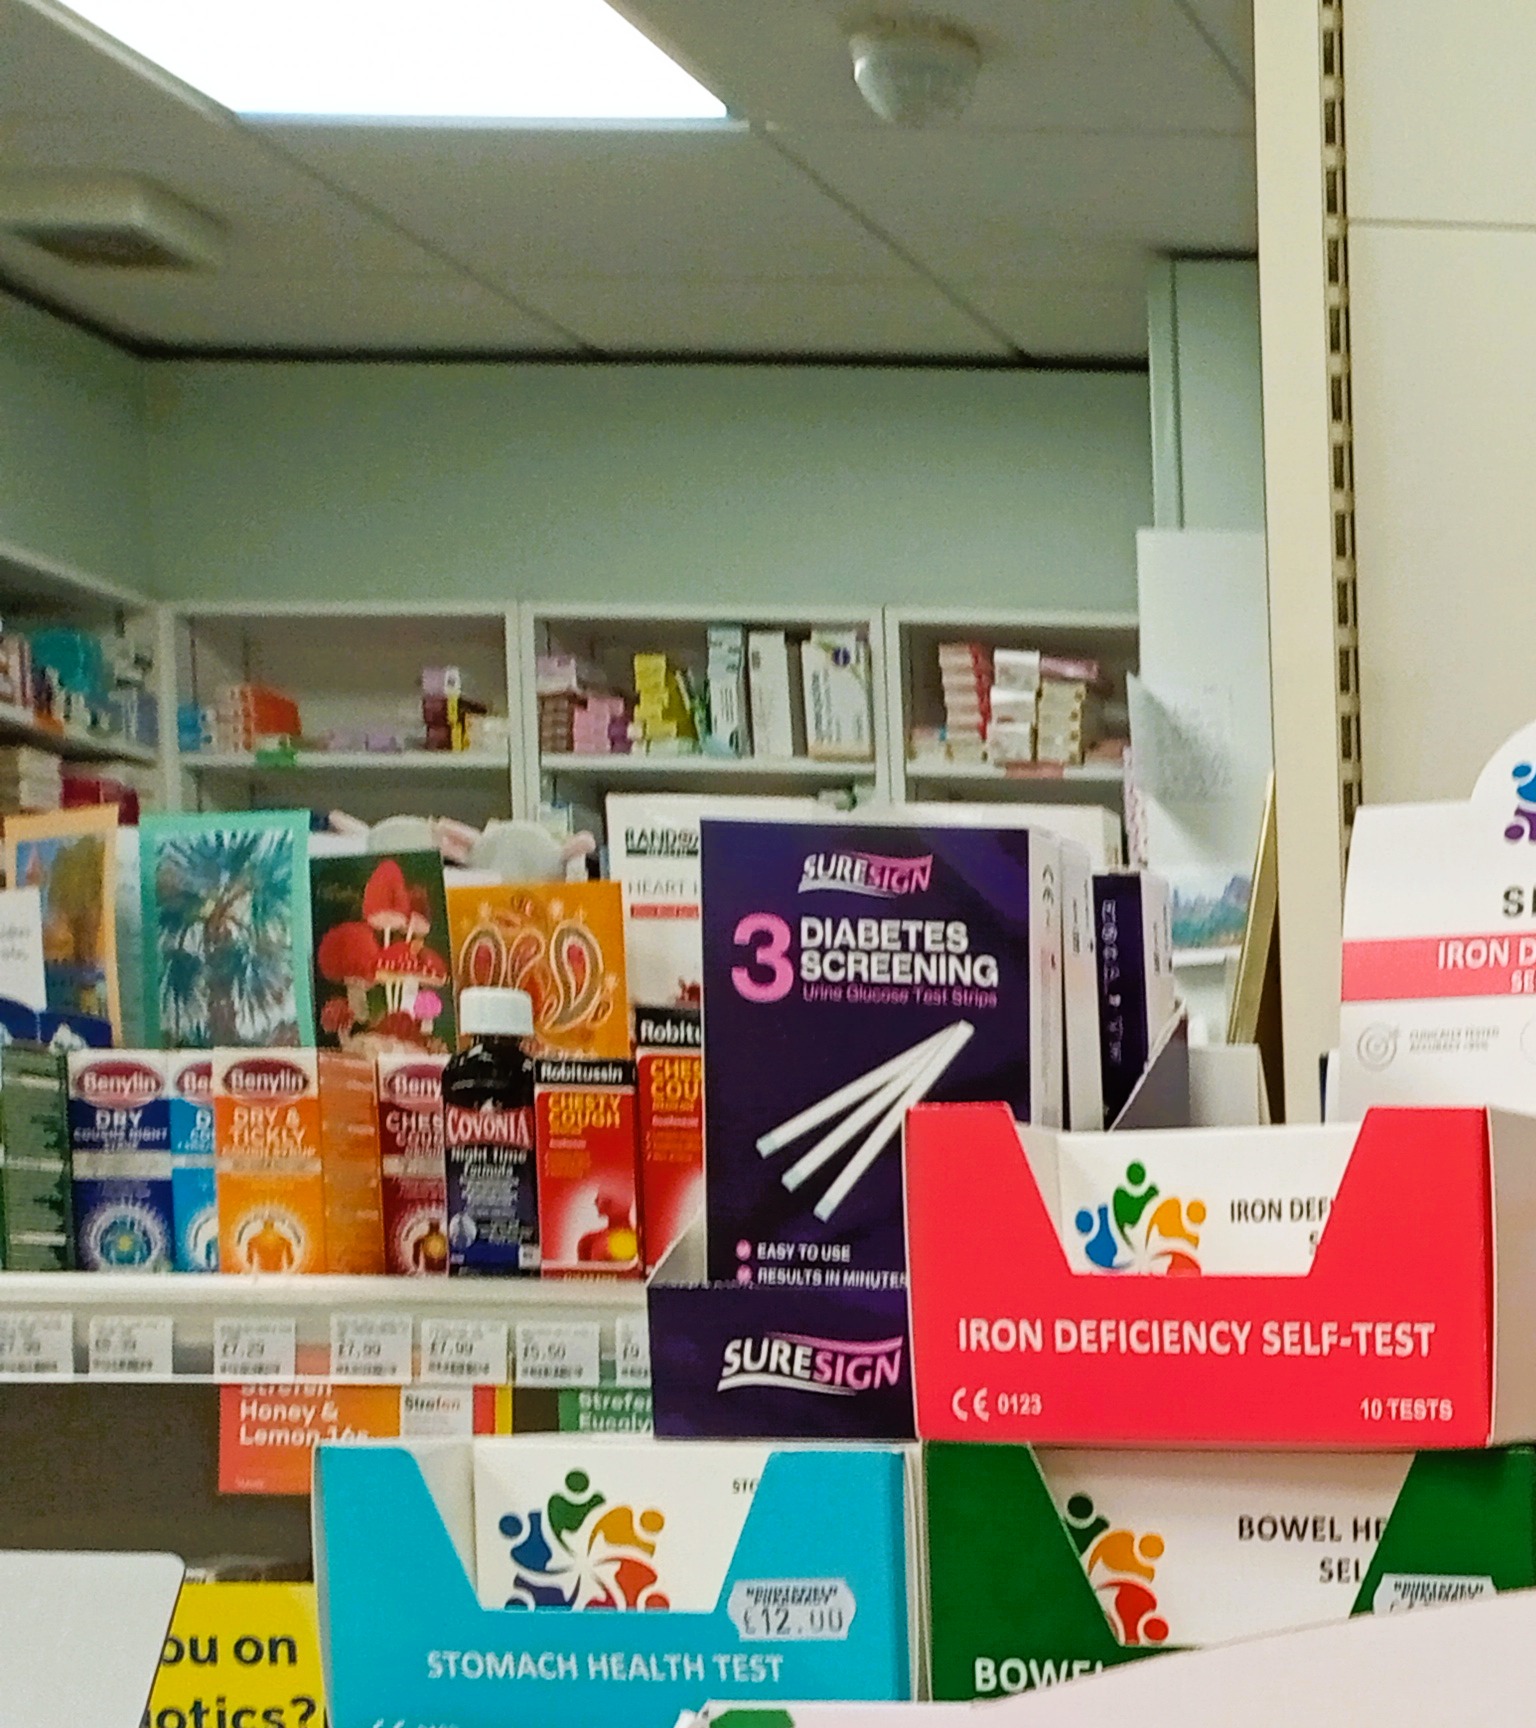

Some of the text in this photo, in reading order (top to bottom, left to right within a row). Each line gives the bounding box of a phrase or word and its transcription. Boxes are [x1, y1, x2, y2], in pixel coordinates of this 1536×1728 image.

[799, 852, 934, 896] SURESIGN
[800, 916, 969, 953] DIABETES
[731, 911, 795, 1004] 3
[1438, 936, 1511, 970] IRON
[800, 951, 999, 988] SCREENING
[802, 985, 998, 1009] Urine Glucose Test Strips
[83, 1071, 158, 1099] Benylin
[230, 1068, 304, 1097] Benylin
[1229, 1199, 1284, 1224] IRON
[757, 1242, 851, 1262] EASY TO USE
[757, 1267, 841, 1287] RESULTS IN
[957, 1316, 1437, 1359] IRON DEFICIENCY SELF-TEST
[718, 1334, 903, 1394] SURESIGN
[239, 1399, 318, 1428] Honey
[996, 1391, 1043, 1417] 0123
[1358, 1398, 1453, 1423] 10 TESTS
[239, 1425, 320, 1447] Lemon
[1238, 1515, 1344, 1545] BOWEL
[741, 1607, 846, 1637] £12.00
[233, 1635, 299, 1666] on
[426, 1651, 784, 1683] STOMACH HEALTH TEST
